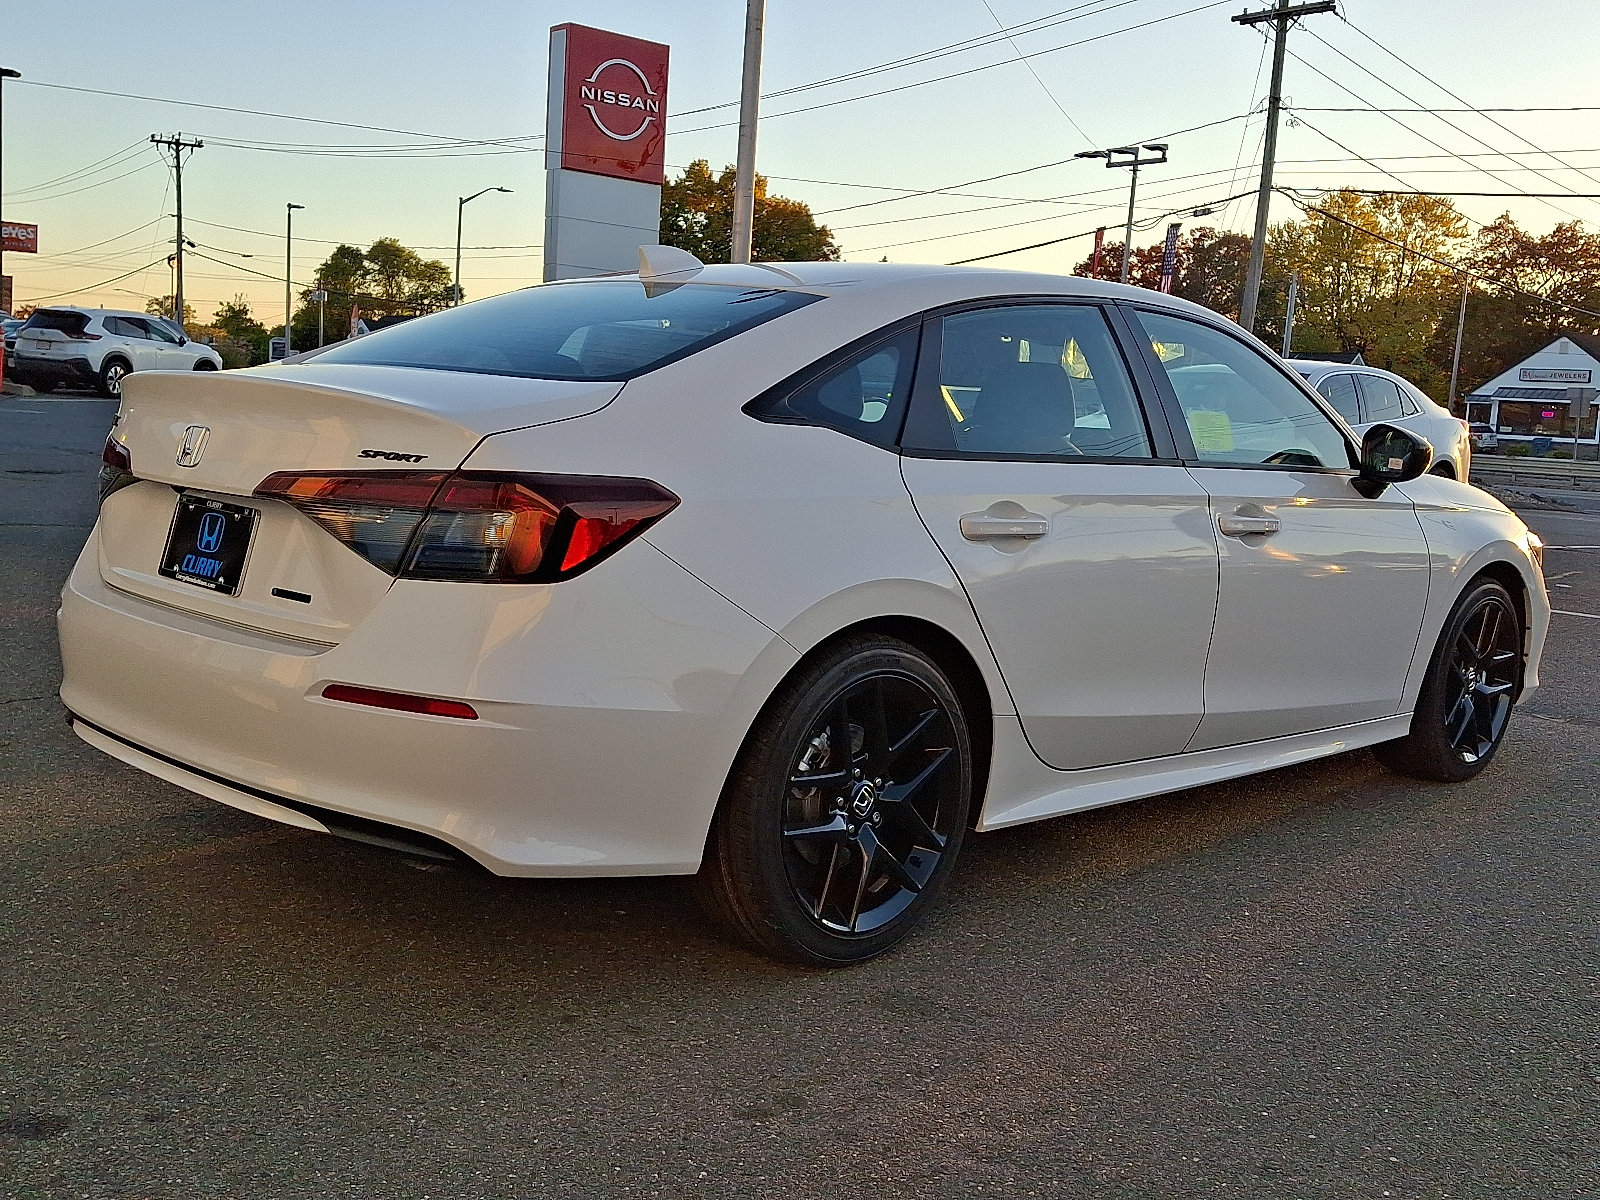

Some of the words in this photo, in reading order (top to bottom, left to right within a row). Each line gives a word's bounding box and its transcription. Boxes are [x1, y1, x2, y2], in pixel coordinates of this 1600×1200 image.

[581, 85, 659, 113] NISSAN
[357, 449, 429, 464] SPORT
[181, 554, 223, 578] CURRY
